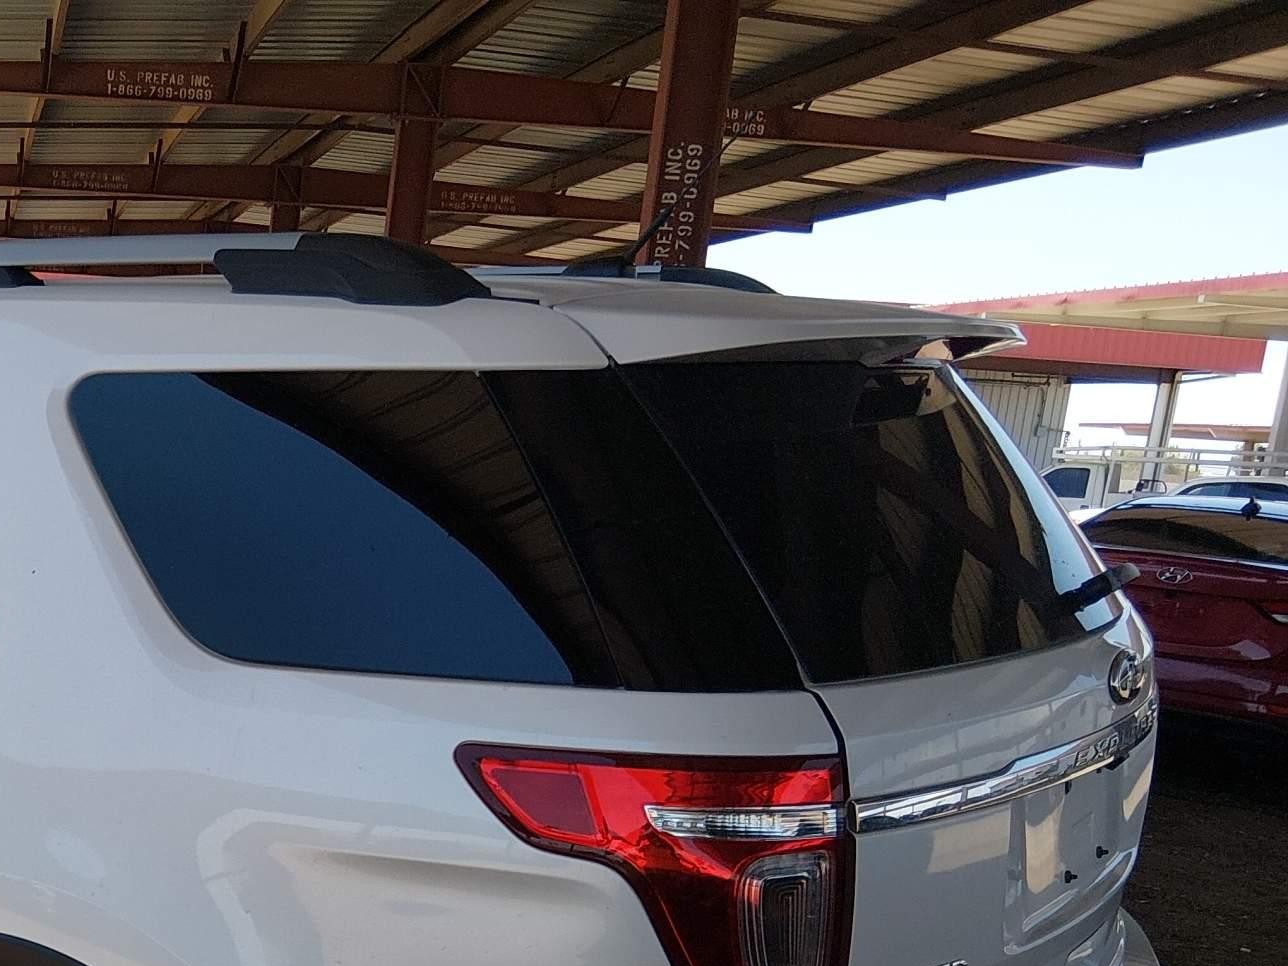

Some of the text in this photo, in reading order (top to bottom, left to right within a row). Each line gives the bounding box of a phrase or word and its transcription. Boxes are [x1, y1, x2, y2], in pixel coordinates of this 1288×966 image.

[107, 69, 214, 88] U.S. PREFAB INC.
[107, 83, 212, 101] 1-866-799-0969
[653, 142, 685, 267] PREFB INC.
[674, 144, 703, 268] -799-0969
